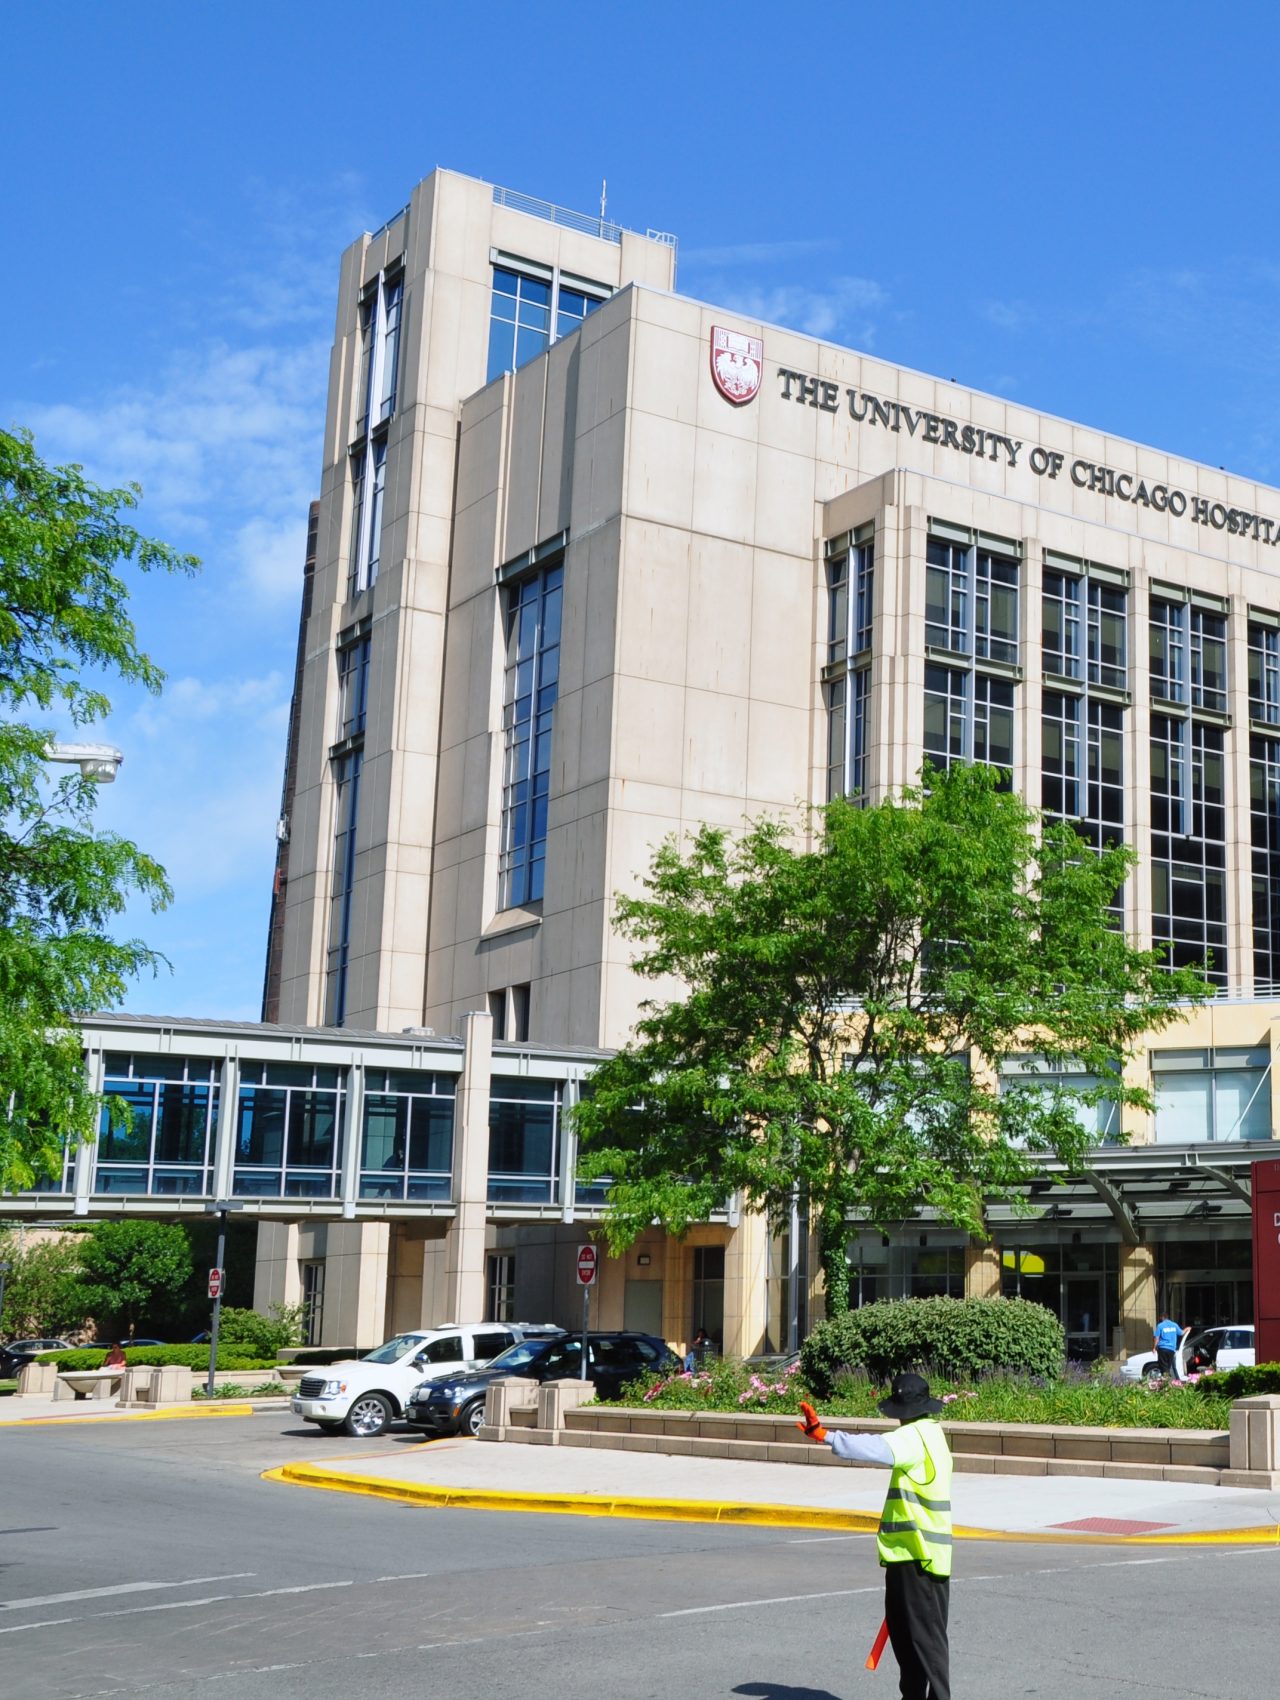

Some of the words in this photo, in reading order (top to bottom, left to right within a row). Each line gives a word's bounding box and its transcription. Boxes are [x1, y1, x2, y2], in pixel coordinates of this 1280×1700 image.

[777, 367, 840, 413] THE
[846, 388, 1023, 467] UNIVERSITY
[1029, 447, 1064, 479] OF
[1070, 460, 1187, 517] CHICAGO
